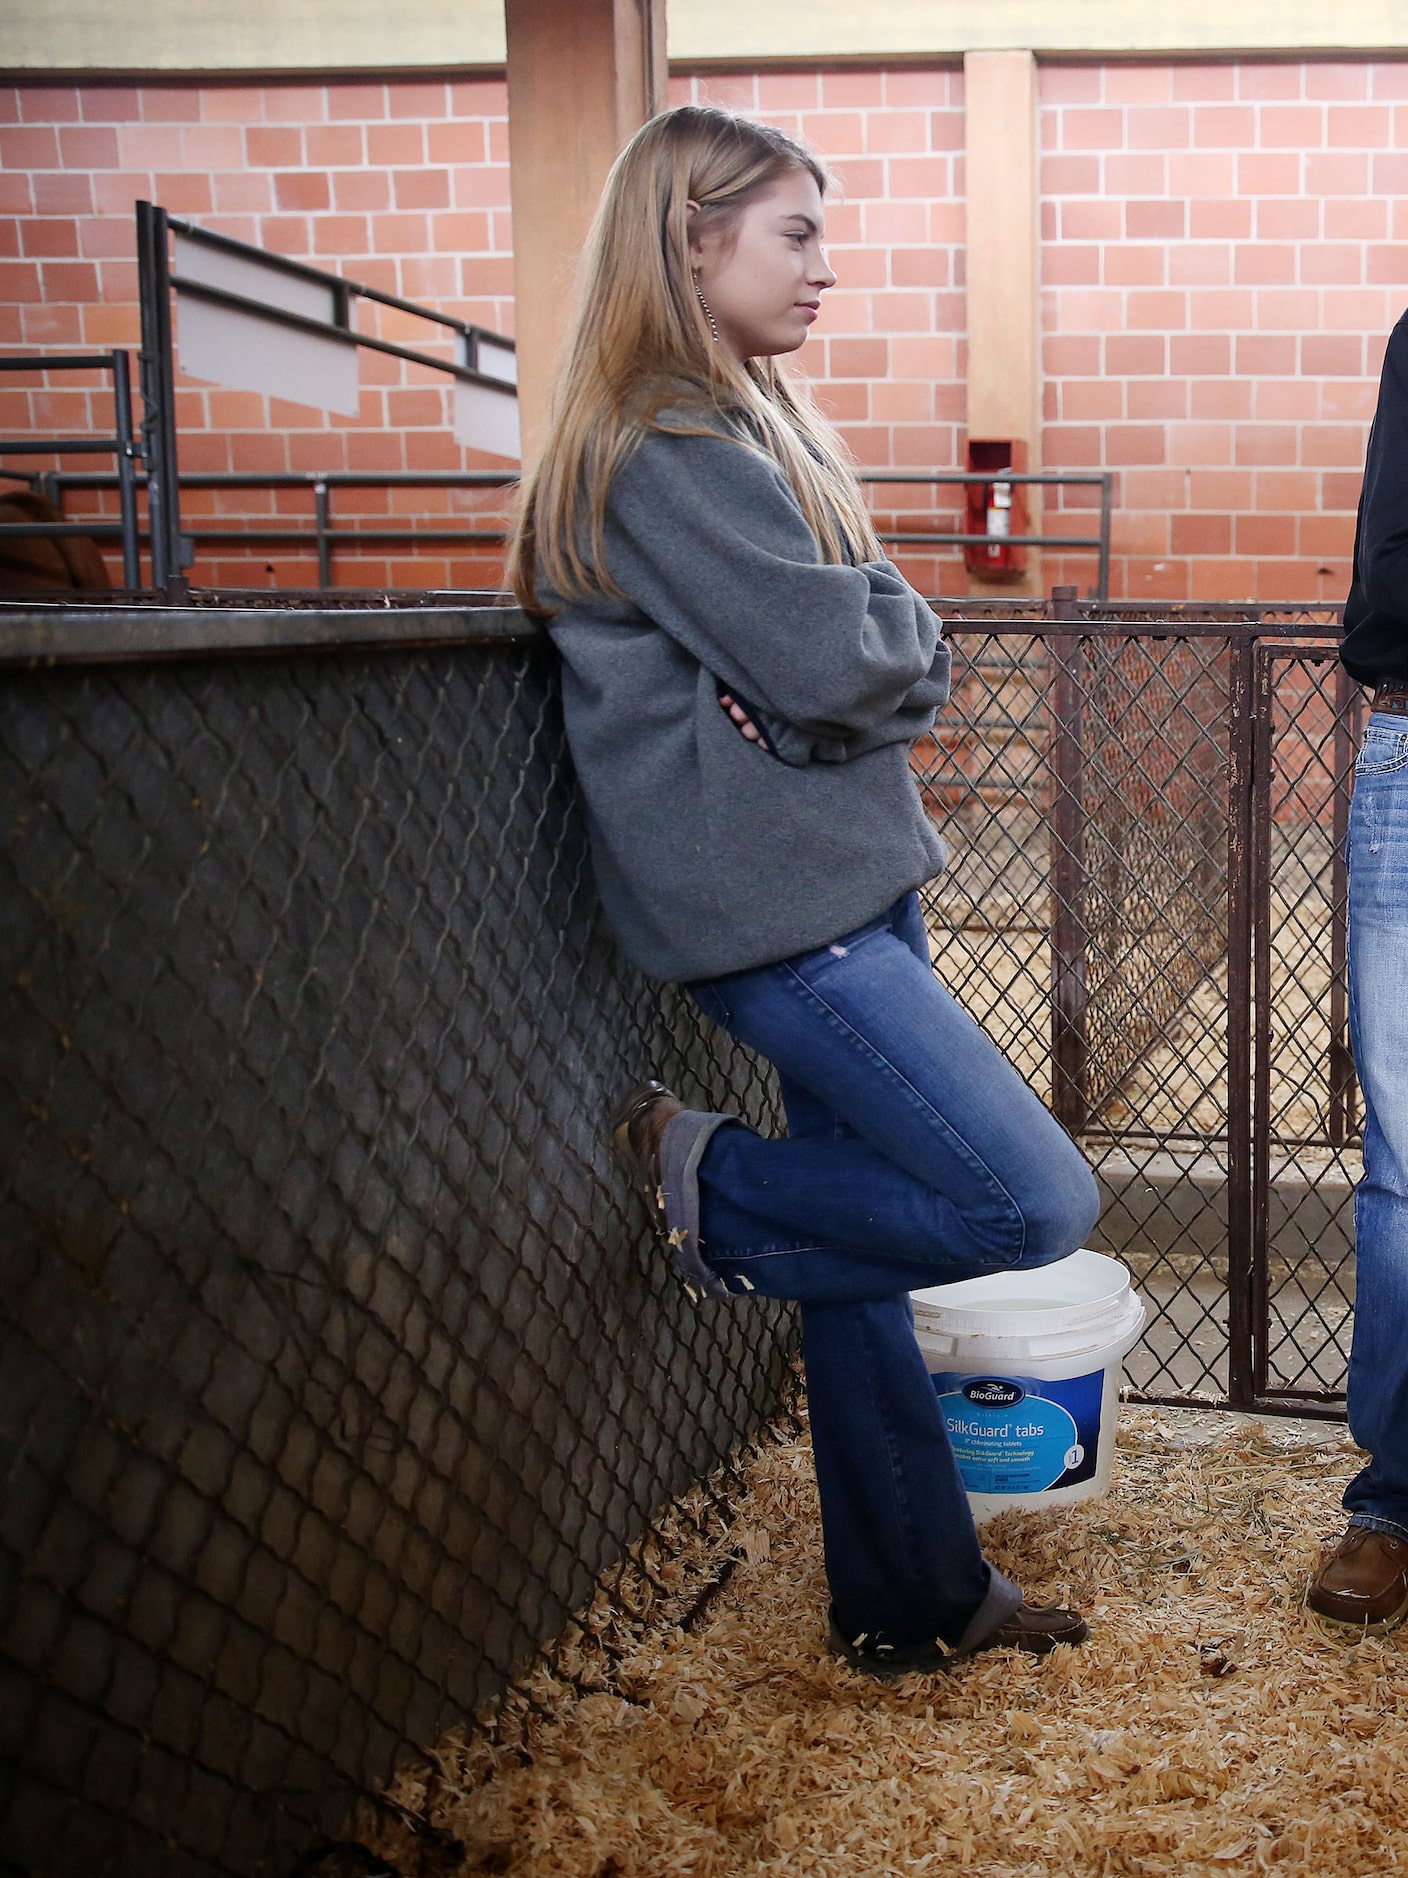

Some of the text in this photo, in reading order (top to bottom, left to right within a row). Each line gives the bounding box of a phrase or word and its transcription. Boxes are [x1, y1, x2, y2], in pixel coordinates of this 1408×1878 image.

[969, 1390, 1015, 1400] BioGuard
[946, 1418, 1044, 1437] SilkGuard tabs
[971, 1439, 1003, 1448] chlorinating
[1005, 1450, 1035, 1458] Technology
[1071, 1449, 1079, 1464] 1
